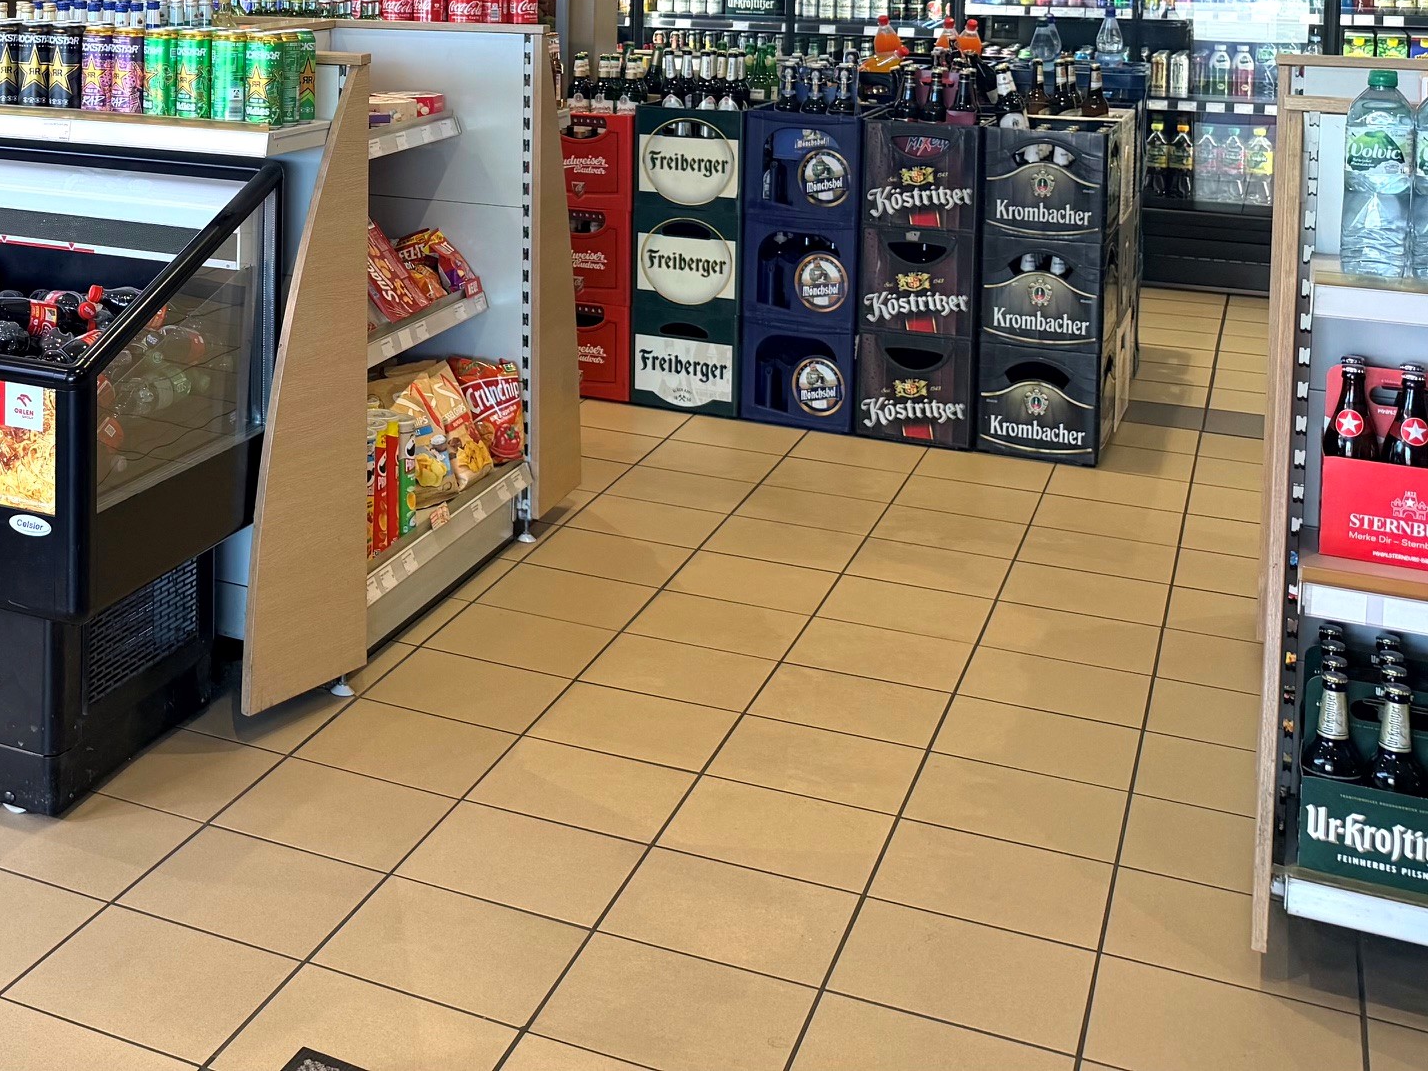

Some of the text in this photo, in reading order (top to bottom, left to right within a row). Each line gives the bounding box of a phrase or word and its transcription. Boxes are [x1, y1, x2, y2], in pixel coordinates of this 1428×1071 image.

[49, 35, 80, 45] CKSTAR
[564, 155, 607, 167] udweiser
[648, 150, 729, 178] Freiberger
[1350, 142, 1401, 160] Volvic
[806, 178, 843, 194] Mönchshof
[867, 185, 973, 218] Köstritzer
[996, 198, 1092, 226] Krombacher
[646, 249, 727, 278] Freiberger
[802, 283, 839, 297] Mönchshof
[863, 291, 969, 323] Köstritzer
[992, 305, 1090, 336] Krombacher
[639, 349, 727, 383] Freiberger
[465, 375, 520, 414] Crunchip
[801, 386, 836, 400] Mönchshof
[14, 407, 34, 416] ORLEN
[861, 396, 966, 428] Köstritzer
[988, 415, 1086, 446] Krombacher
[16, 517, 44, 532] Celsior
[1348, 531, 1376, 542] Merke
[1378, 535, 1392, 544] Dir
[1349, 512, 1428, 537] STERNB
[1305, 803, 1428, 863] Ur-Krosti
[1337, 853, 1398, 874] FEINHERBES
